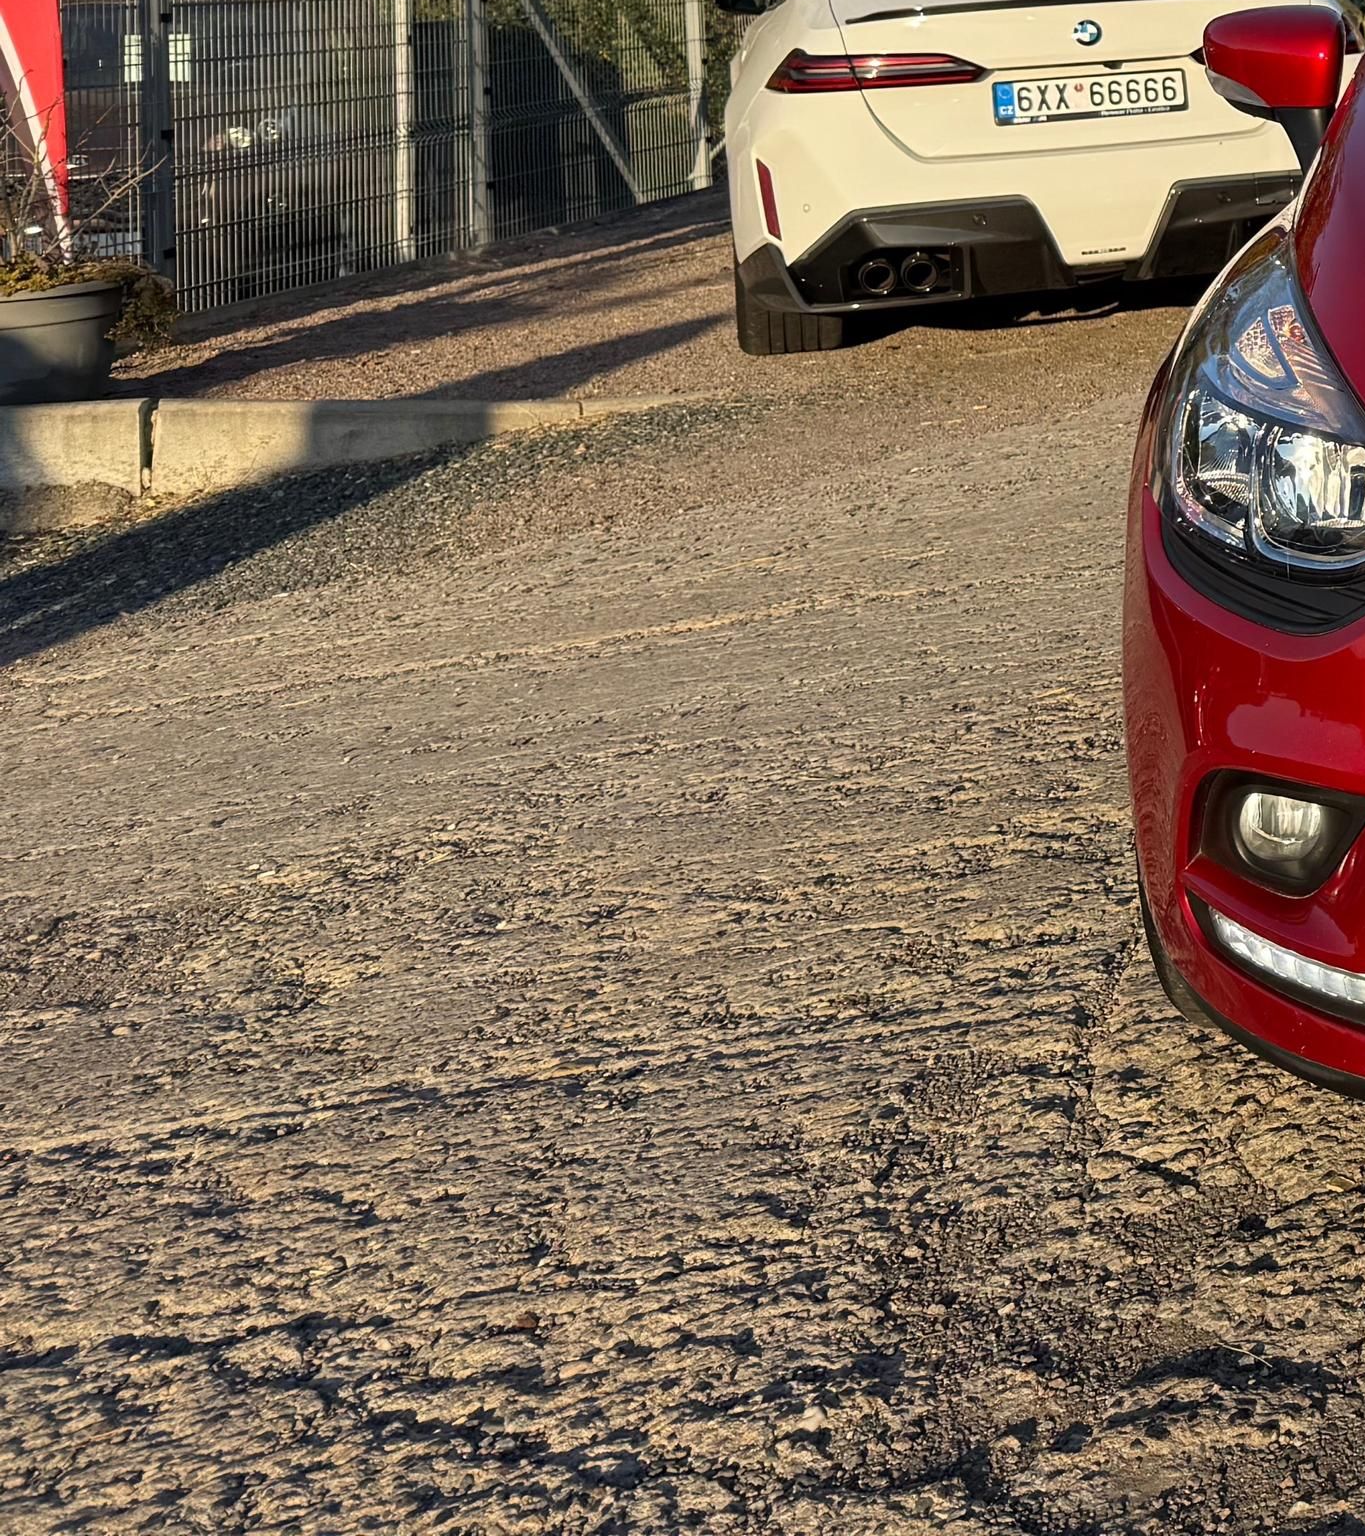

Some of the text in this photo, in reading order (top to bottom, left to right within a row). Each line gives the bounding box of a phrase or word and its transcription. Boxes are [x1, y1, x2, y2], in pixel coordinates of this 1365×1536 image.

[1017, 76, 1177, 112] 6XX 66666
[1000, 105, 1015, 116] CZ
